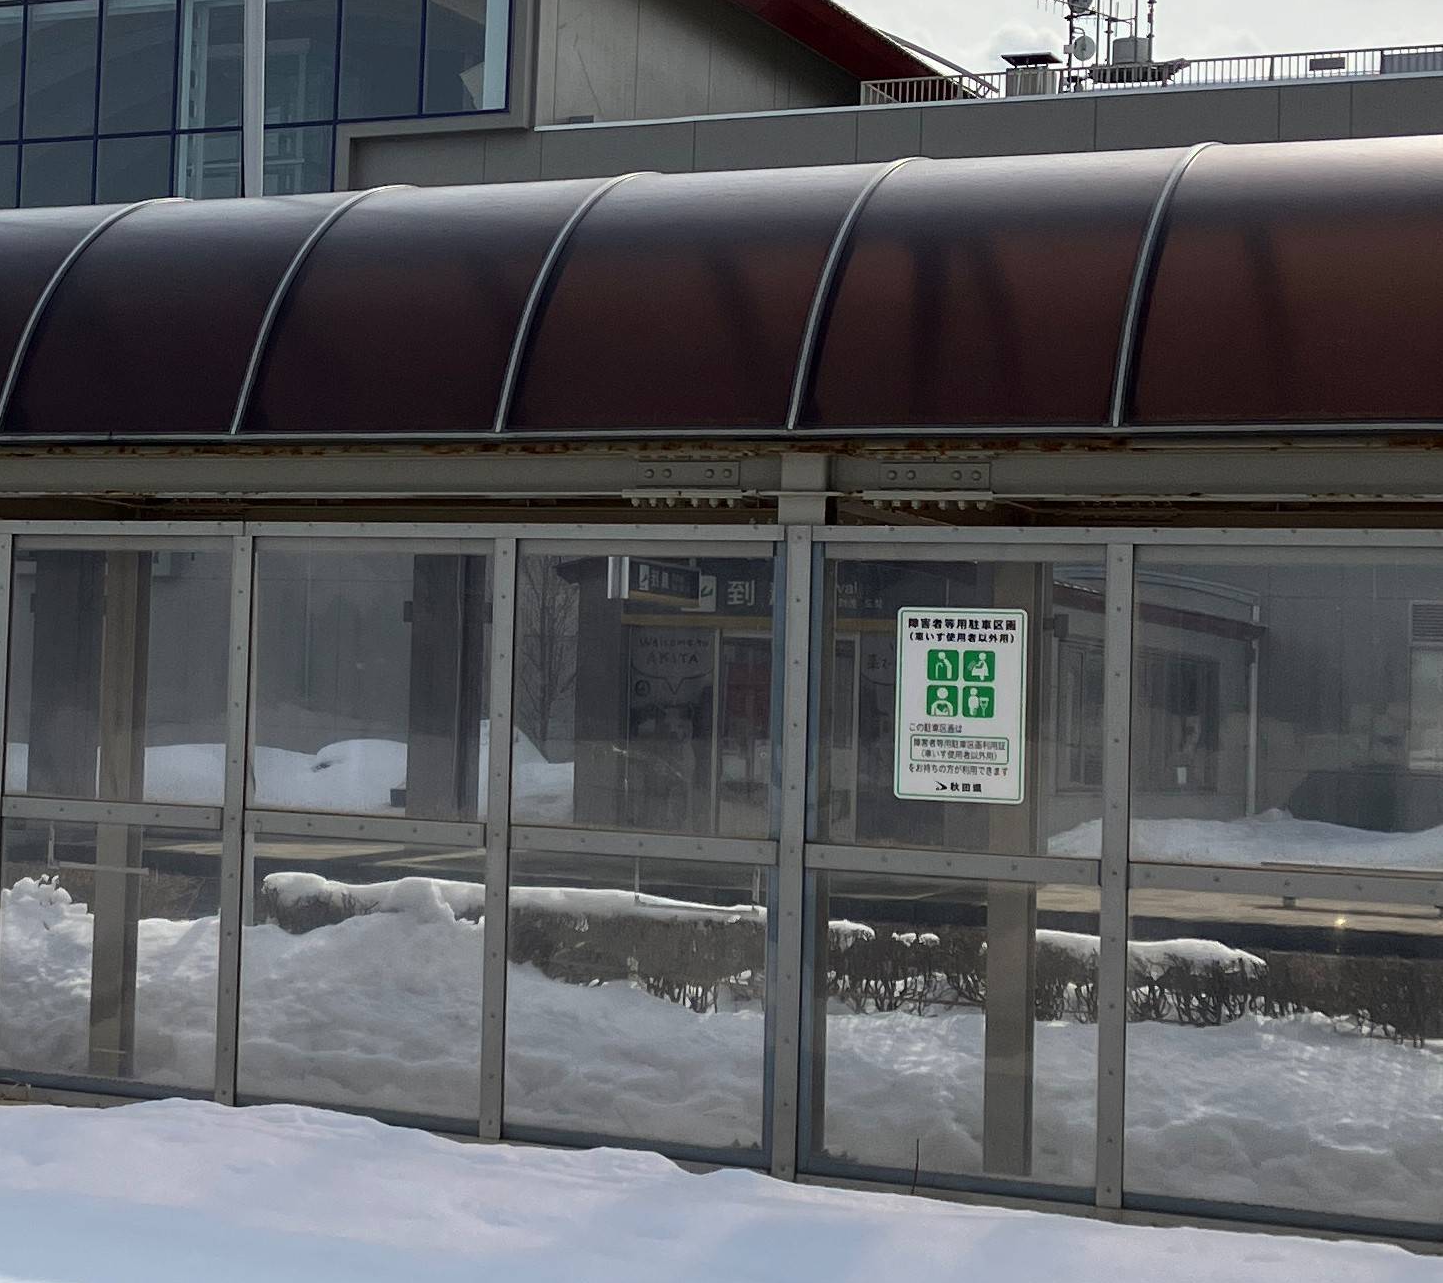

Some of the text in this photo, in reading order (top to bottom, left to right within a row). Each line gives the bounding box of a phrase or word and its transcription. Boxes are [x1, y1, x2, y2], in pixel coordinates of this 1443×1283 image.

[908, 618, 1017, 631] 障害者等用駐車区画
[646, 651, 699, 666] AKITA
[909, 763, 1008, 777] をお持ちの方が利用できます
